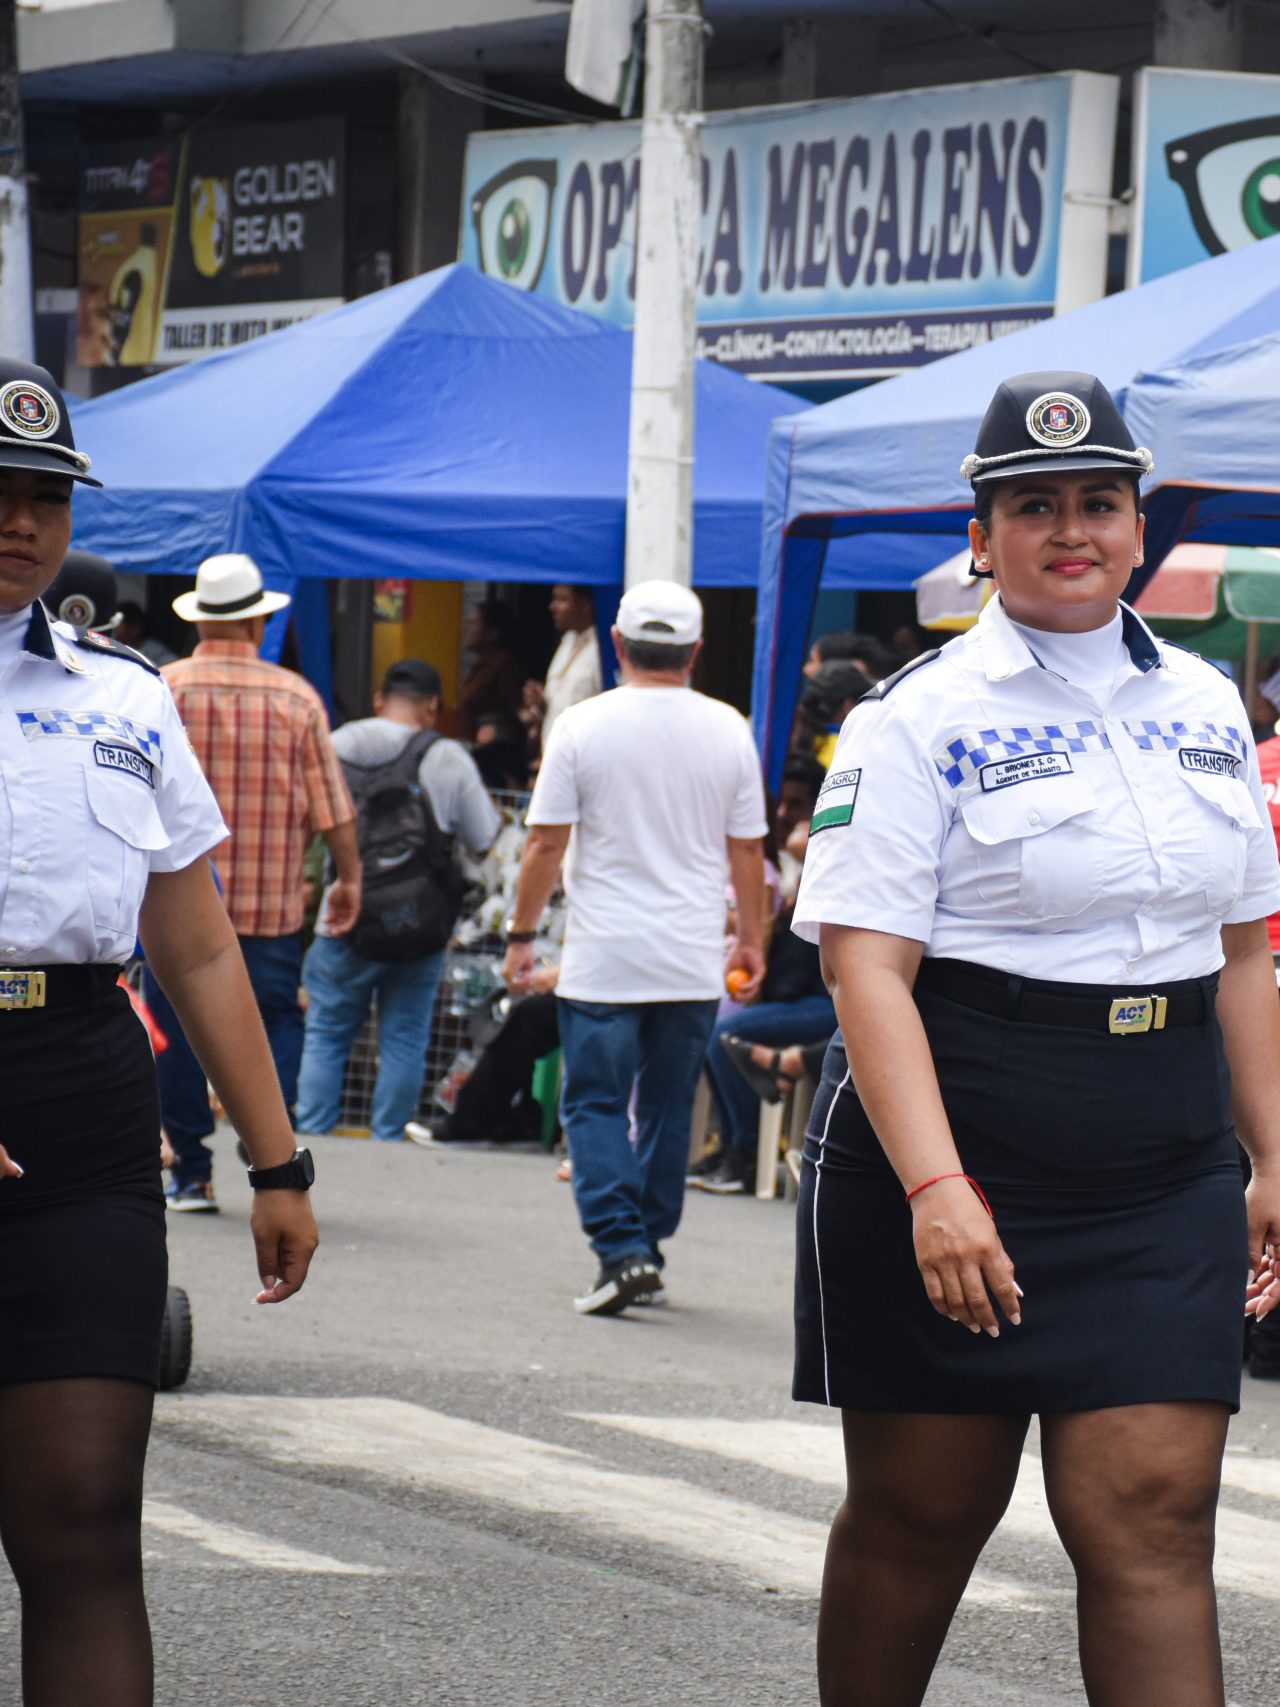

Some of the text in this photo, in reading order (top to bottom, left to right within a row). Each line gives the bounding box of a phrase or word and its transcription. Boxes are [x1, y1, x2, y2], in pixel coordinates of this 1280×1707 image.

[233, 158, 336, 207] GOLDEN
[761, 116, 1047, 293] MEGALENS
[233, 211, 305, 256] BEAR
[164, 322, 206, 349] TALLER
[209, 321, 225, 347] DE
[98, 747, 151, 781] TRANSITO
[1005, 760, 1035, 773] BRIONES
[1184, 751, 1235, 775] TRANSITO
[996, 774, 1019, 785] AGENTE
[1115, 1004, 1147, 1021] ACT
